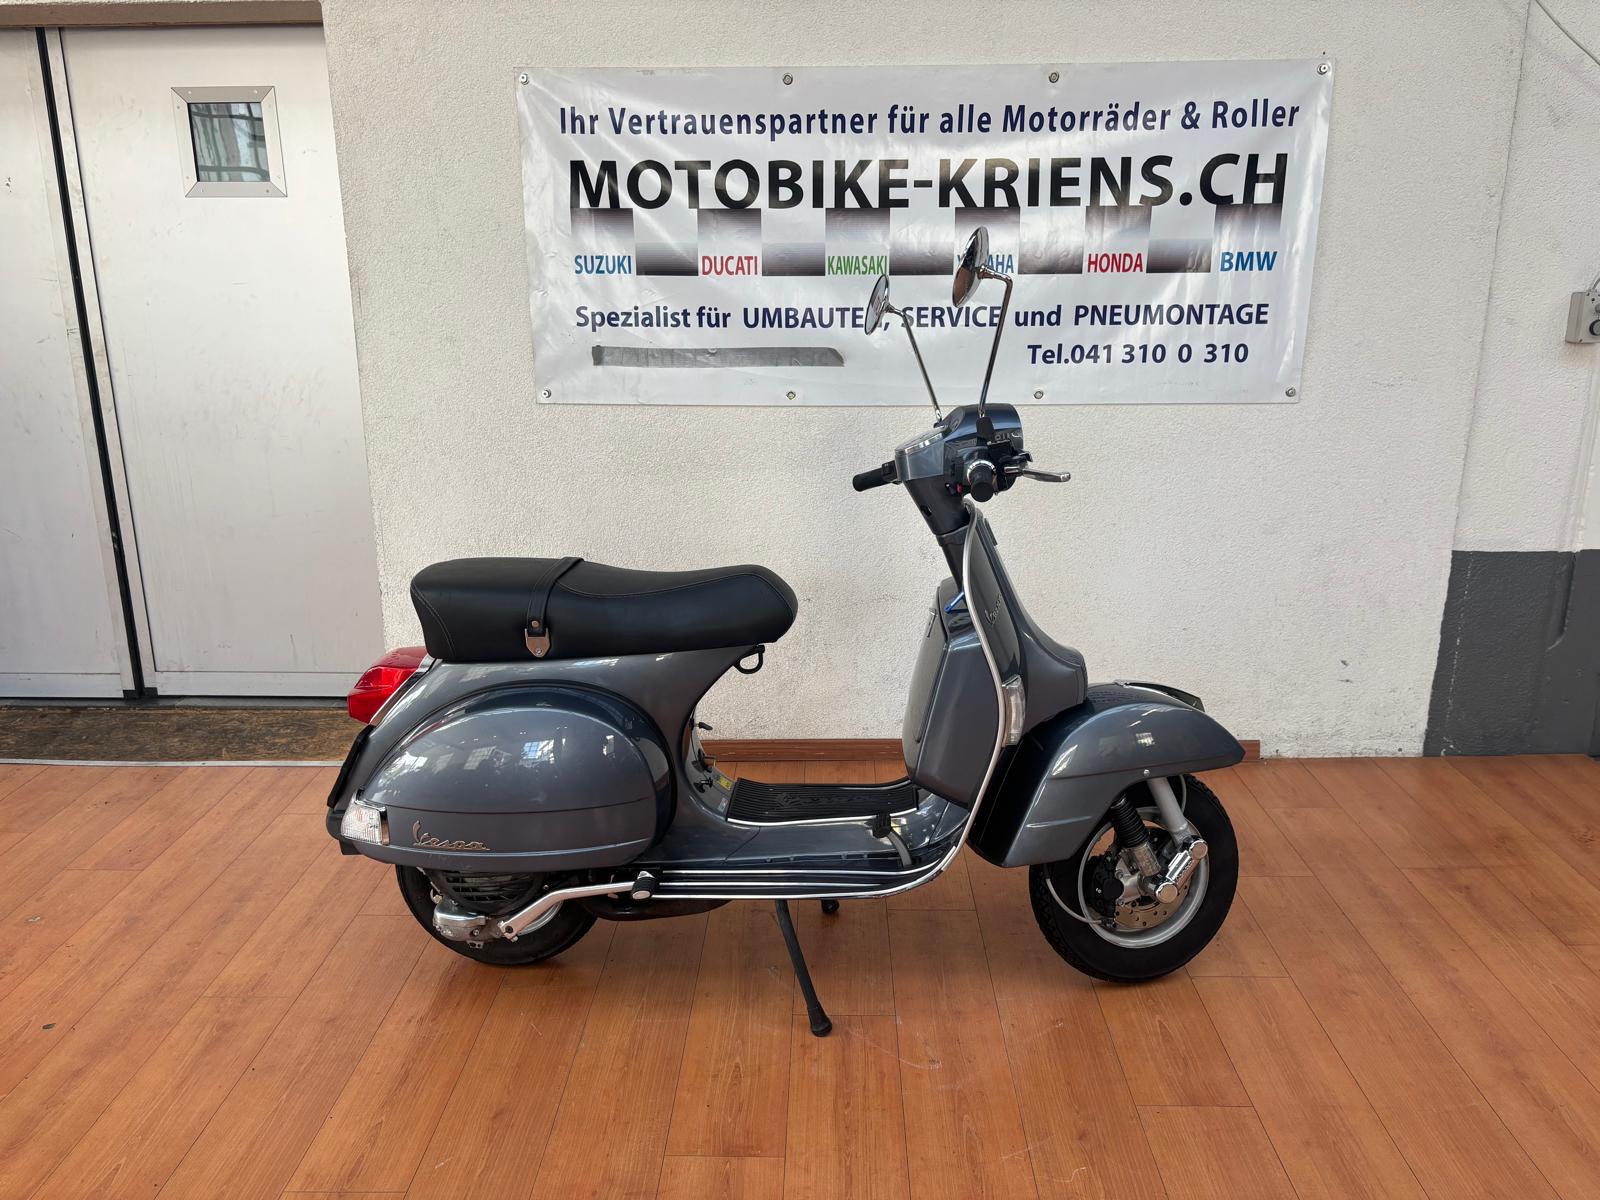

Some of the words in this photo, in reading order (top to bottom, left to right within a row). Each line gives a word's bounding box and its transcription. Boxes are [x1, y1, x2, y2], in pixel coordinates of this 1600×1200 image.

[560, 106, 599, 134] Ihr
[608, 107, 878, 142] Vertrauenspartner
[888, 104, 930, 134] für
[939, 103, 992, 134] alle
[1002, 101, 1171, 132] Motorräder
[1180, 102, 1200, 129] &
[1212, 98, 1300, 128] Roller
[569, 152, 1288, 210] MOTOBIKE-KRIENS.CH
[574, 255, 632, 275] SUZUKI
[701, 255, 758, 276] DUCATI
[827, 254, 888, 275] KAWASAKI
[957, 254, 1014, 274] AHA
[1087, 252, 1144, 273] HONDA
[1220, 251, 1278, 272] BMW
[576, 305, 691, 332] Spezialist
[697, 305, 731, 328] für
[743, 306, 890, 331] UMBAUTE,
[901, 305, 1001, 328] SERVICE
[1015, 303, 1061, 327] und
[1074, 303, 1269, 326] PNEUMONTAGE
[1121, 344, 1166, 364] 310
[1178, 343, 1192, 363] 0
[1204, 343, 1249, 363] 310
[412, 820, 490, 850] Vespa
